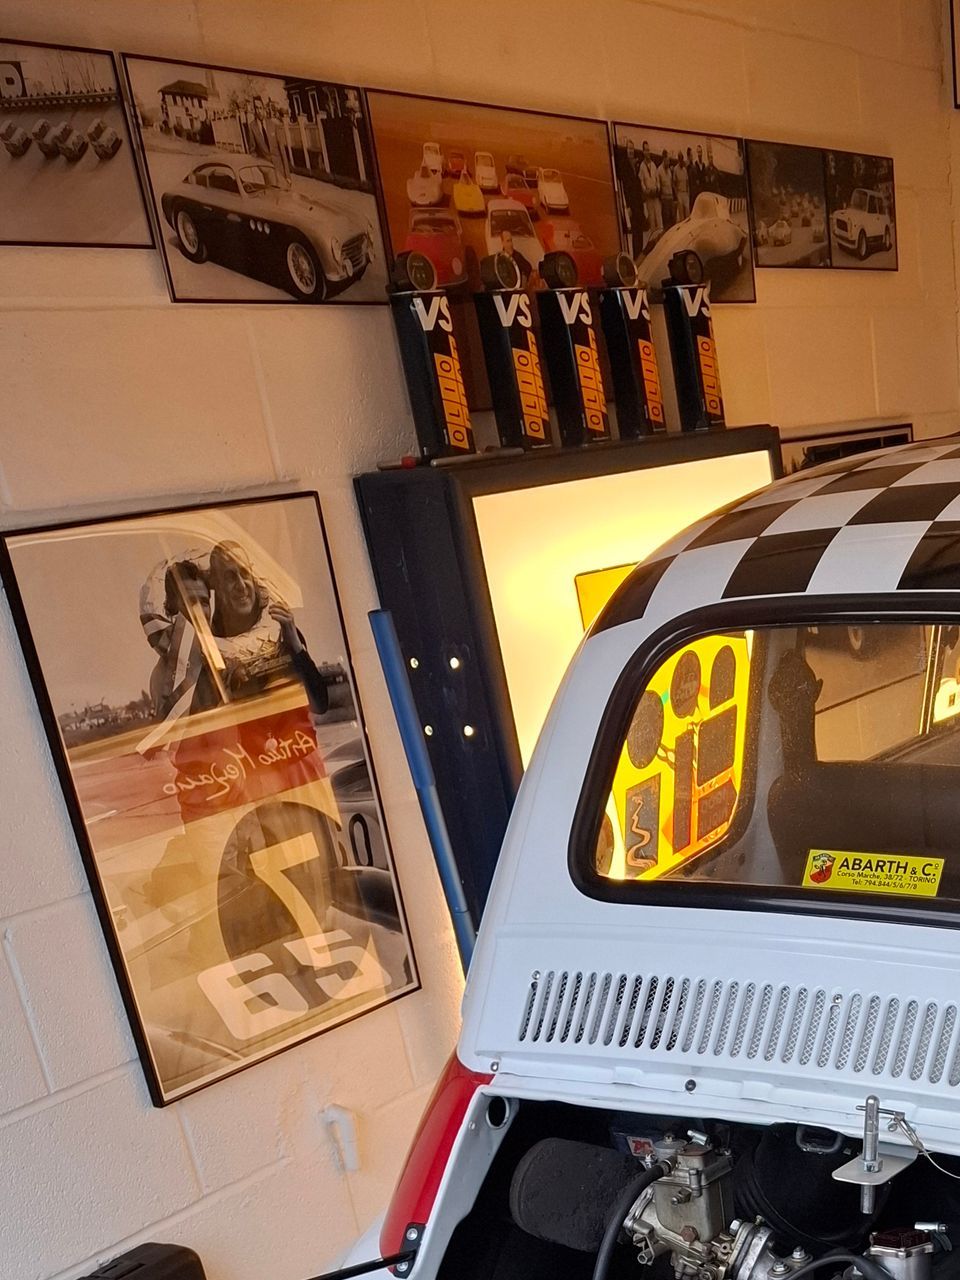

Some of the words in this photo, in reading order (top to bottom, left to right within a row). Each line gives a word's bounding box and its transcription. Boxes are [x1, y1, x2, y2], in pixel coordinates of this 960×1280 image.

[412, 297, 453, 332] VS
[493, 293, 533, 328] VS
[556, 290, 593, 326] VS
[621, 289, 651, 321] VS
[684, 285, 712, 318] VS
[517, 354, 541, 433] OLIO
[579, 350, 601, 426] OLIO
[642, 344, 660, 417] OLIO
[700, 341, 719, 410] OLIO
[440, 360, 465, 443] OLIO
[837, 870, 855, 878] Corso
[908, 875, 937, 884] TORINO
[838, 857, 909, 875] ABARTH
[910, 866, 917, 876] &
[197, 929, 393, 1041] 65
